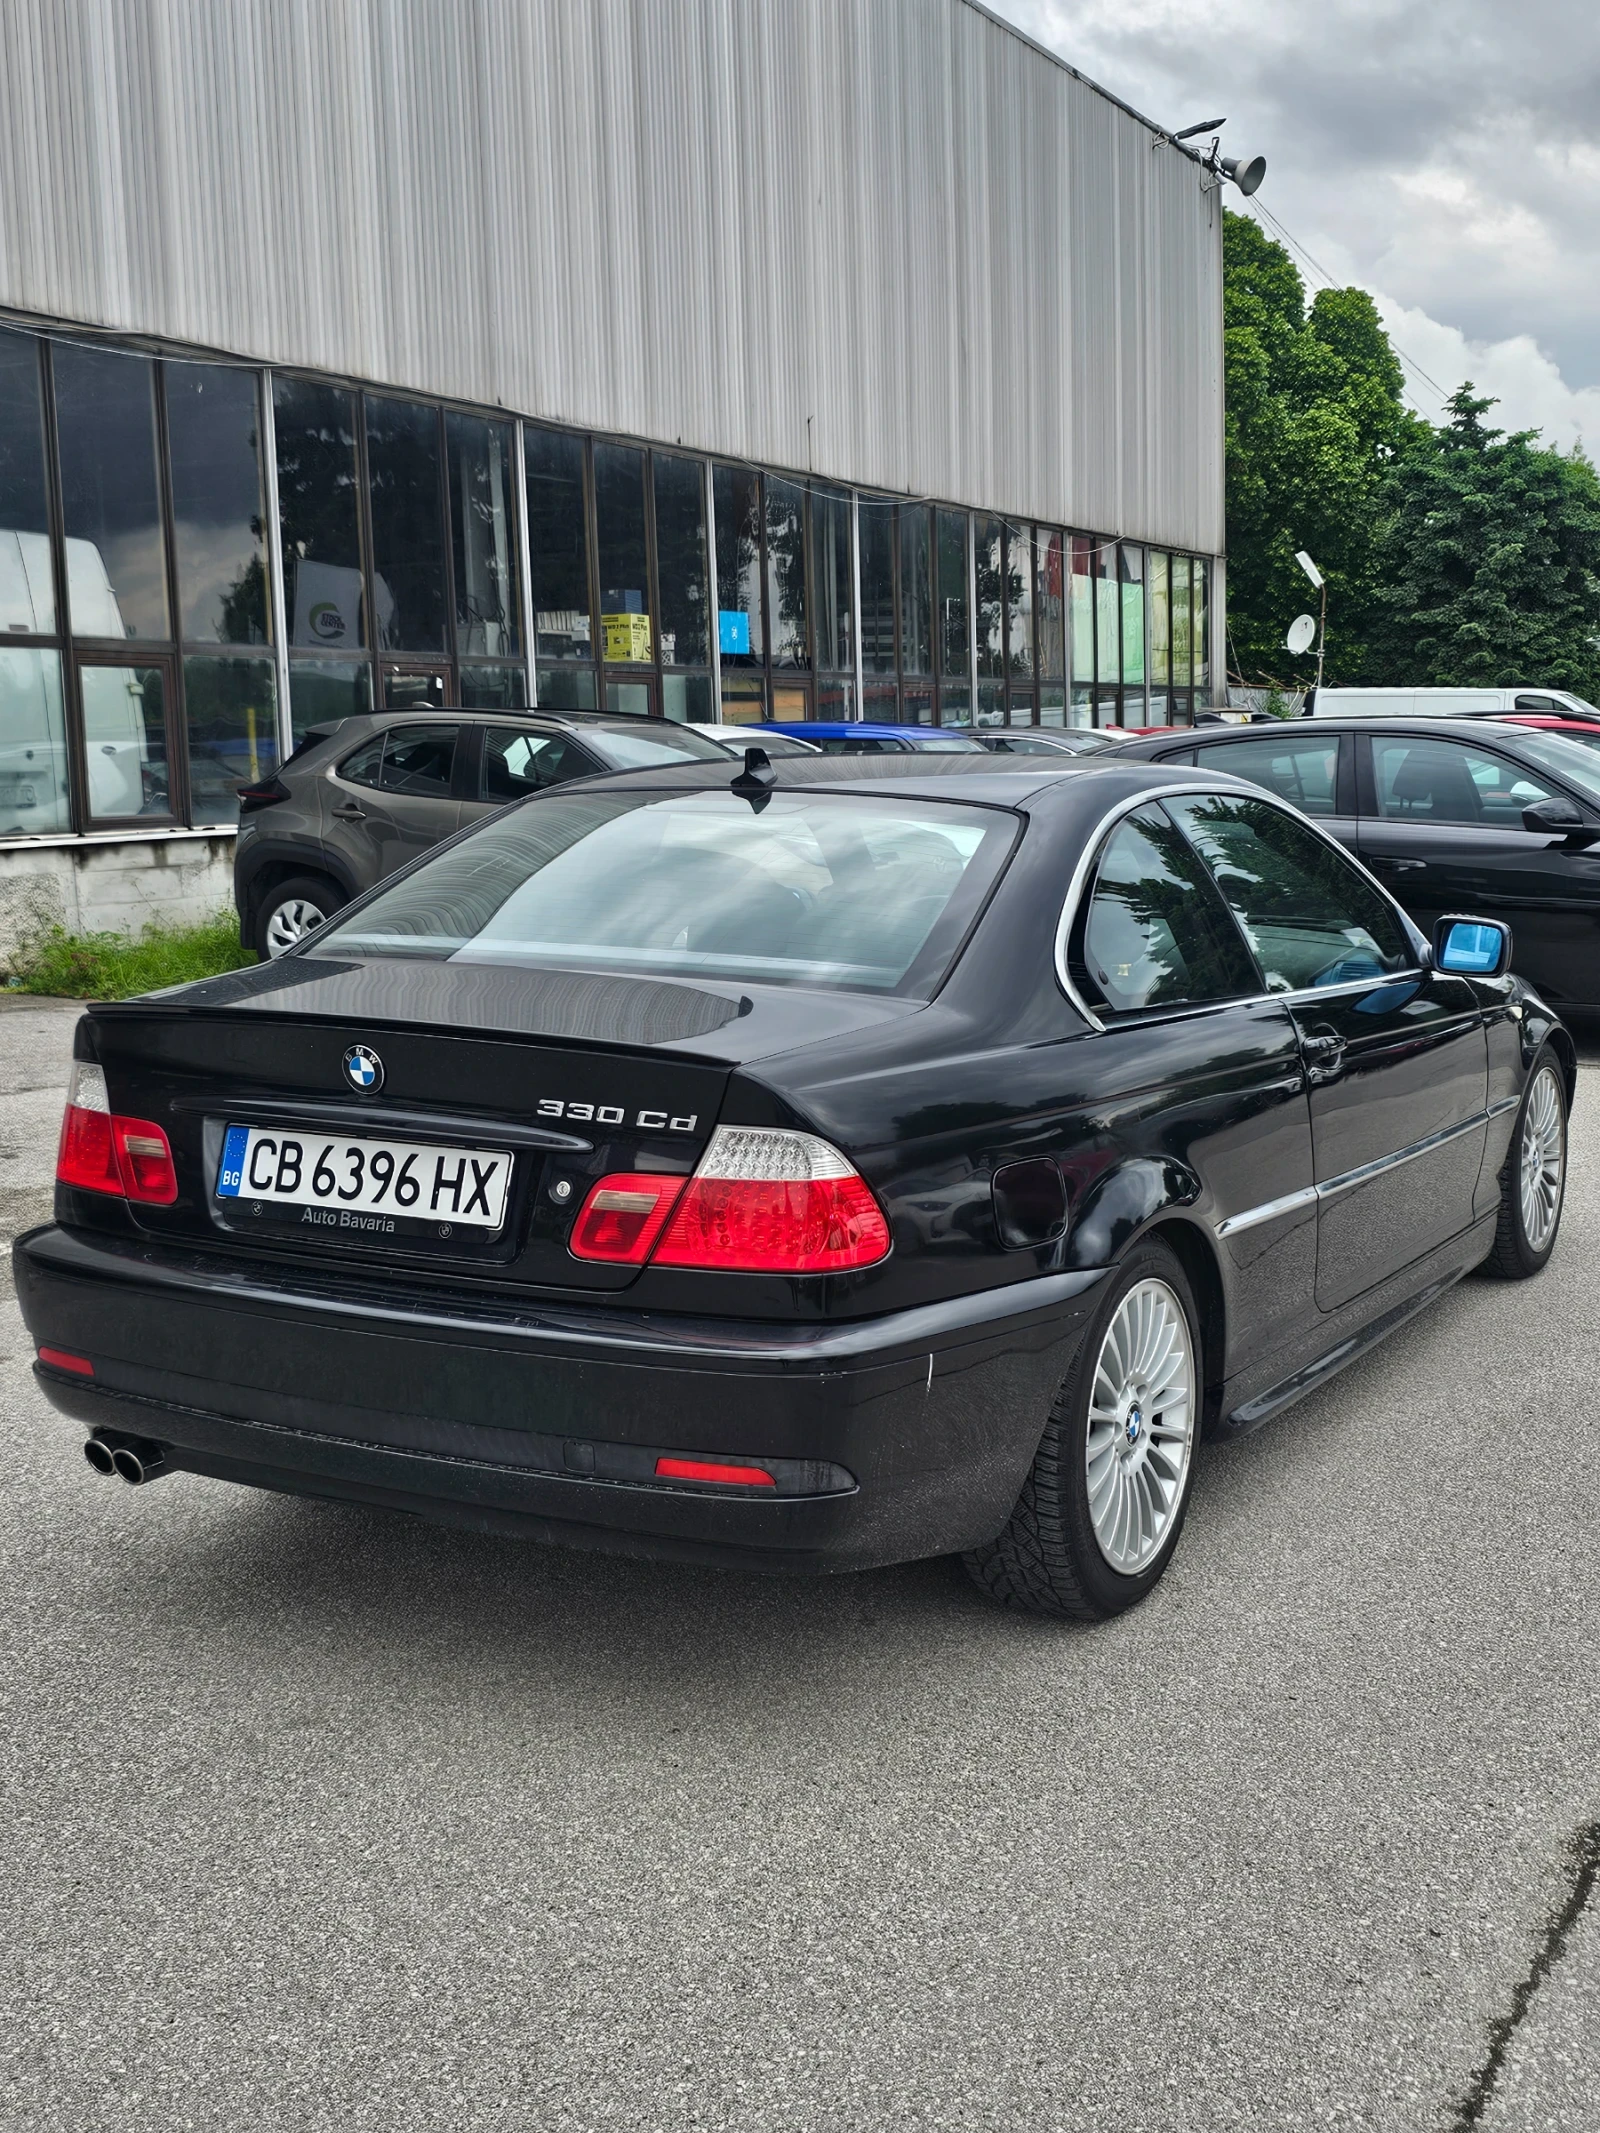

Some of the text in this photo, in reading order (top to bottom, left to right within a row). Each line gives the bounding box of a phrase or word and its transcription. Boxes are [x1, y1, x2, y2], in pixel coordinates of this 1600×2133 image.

[345, 1047, 378, 1064] BMW
[536, 1098, 698, 1132] 330 Cd
[222, 1170, 240, 1187] BG
[249, 1138, 499, 1216] CB 6396 HX
[301, 1206, 396, 1233] Auto Bavaria
